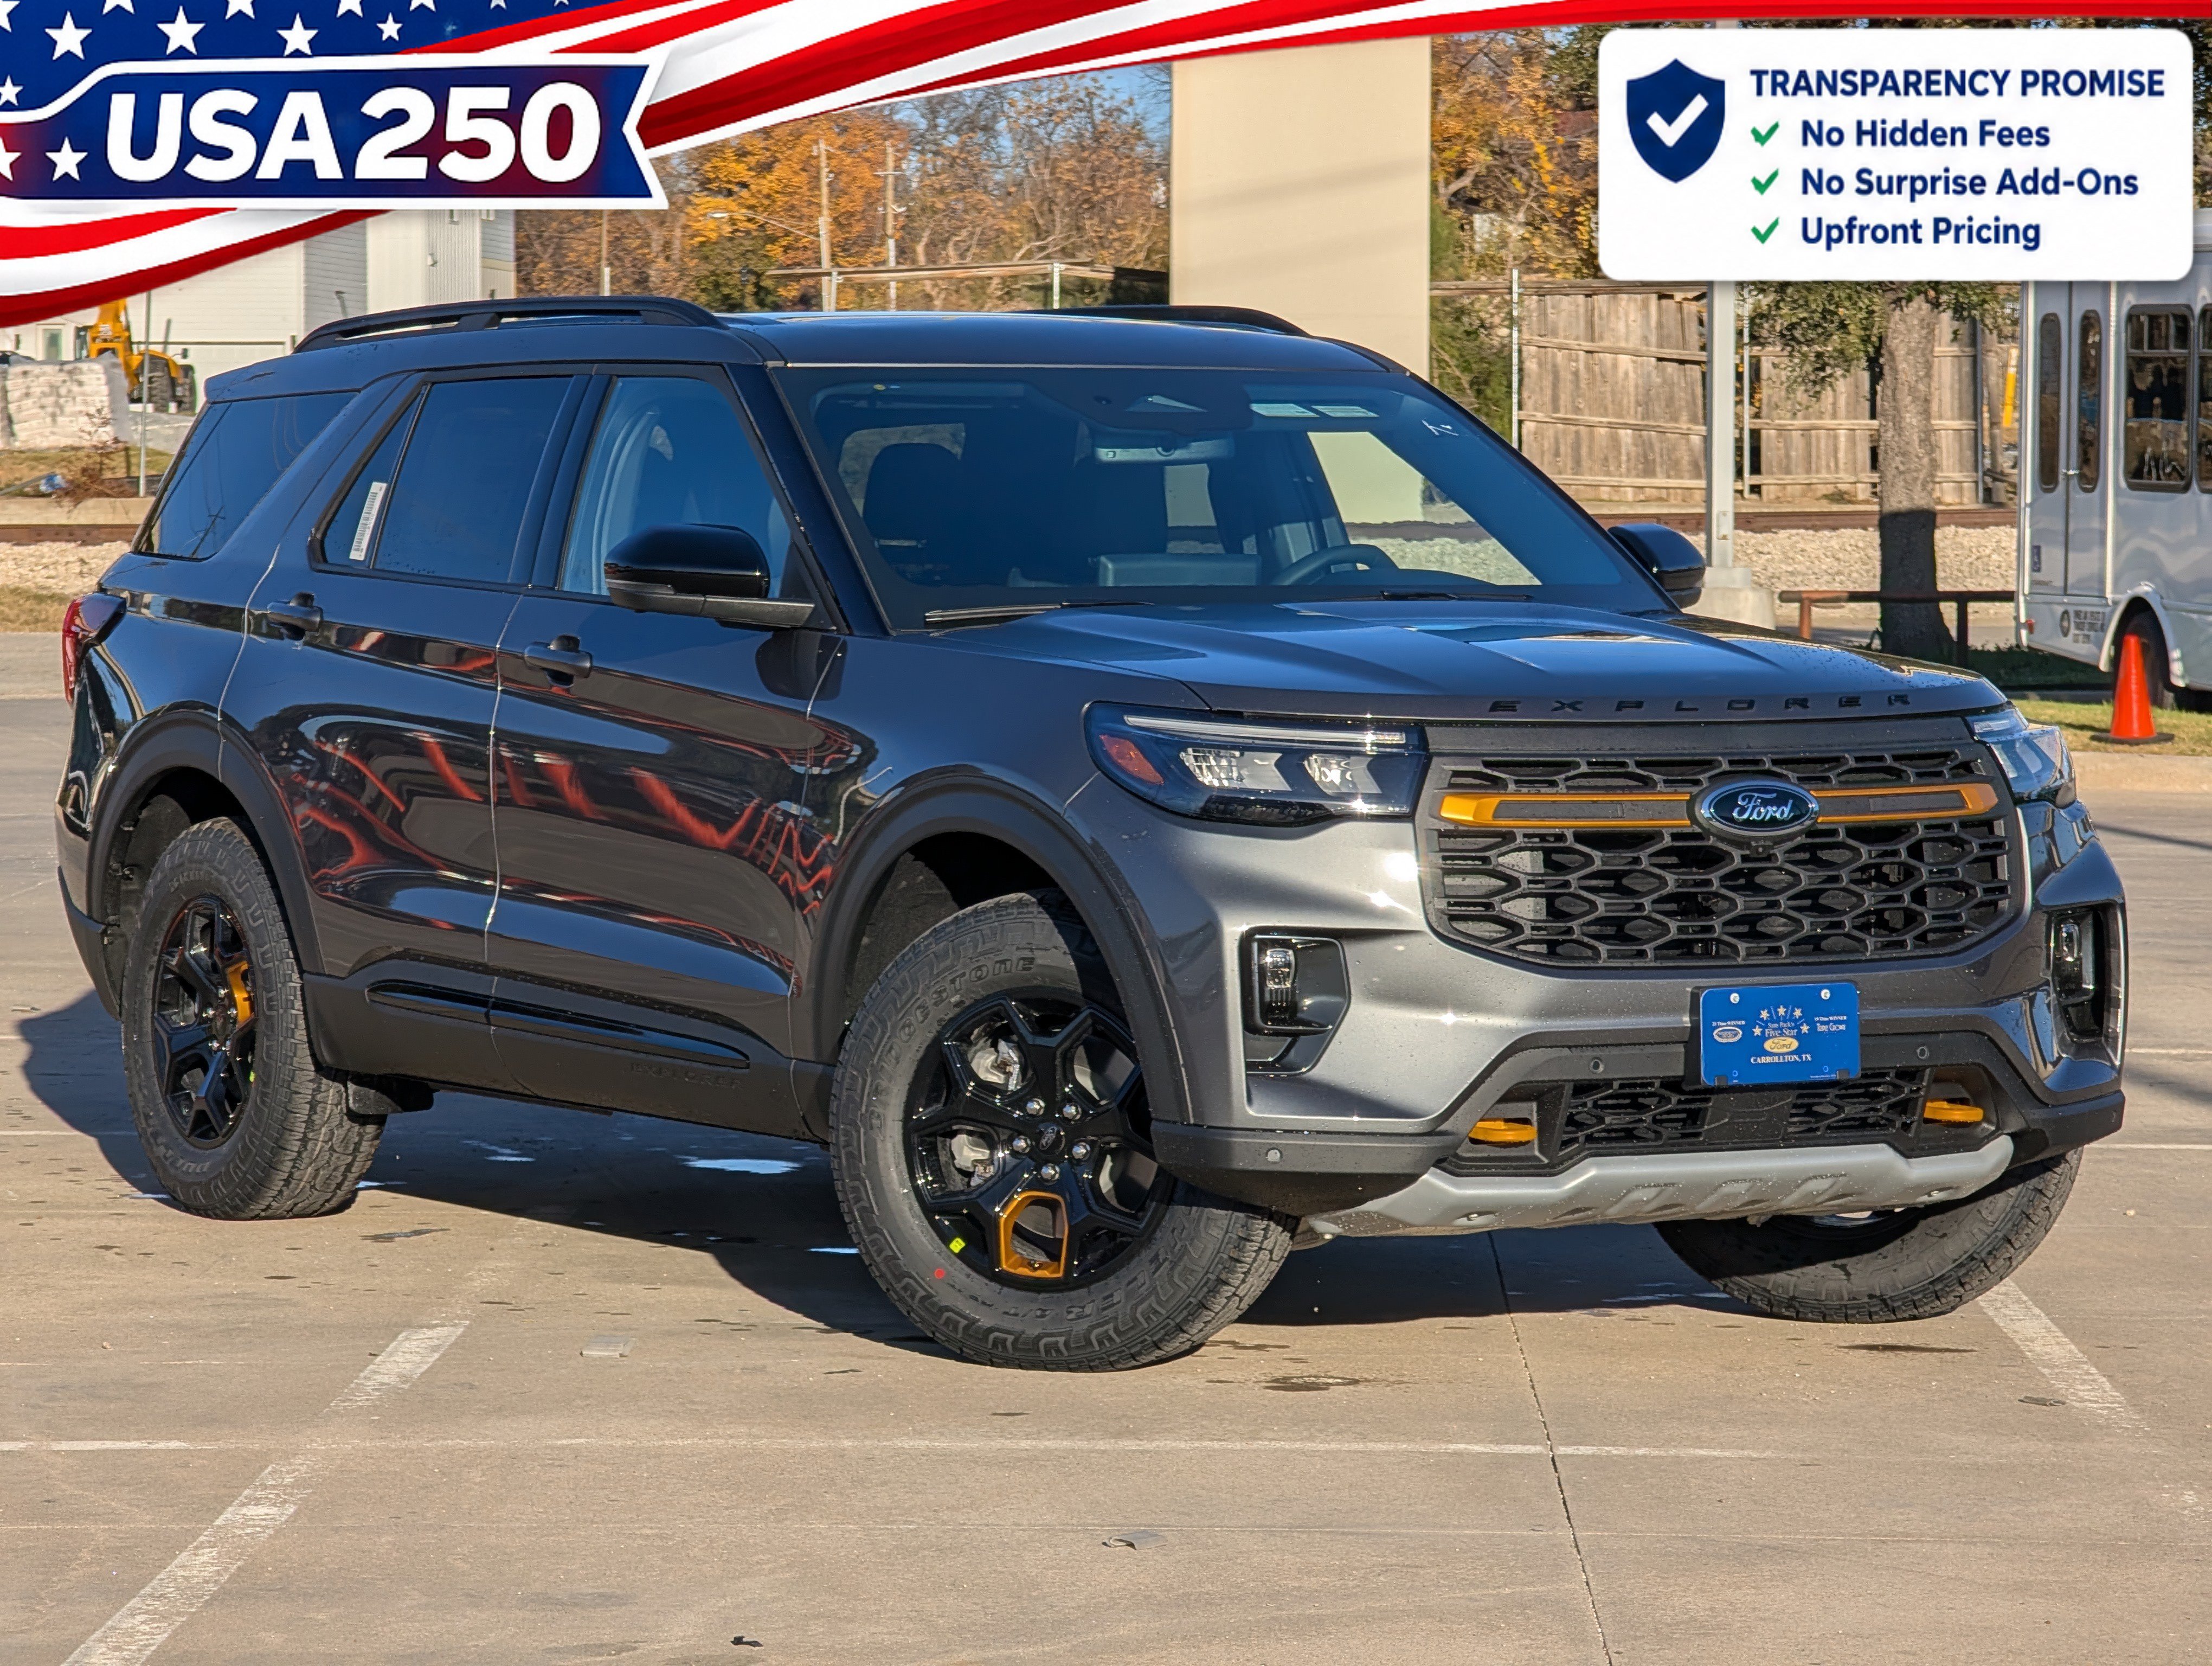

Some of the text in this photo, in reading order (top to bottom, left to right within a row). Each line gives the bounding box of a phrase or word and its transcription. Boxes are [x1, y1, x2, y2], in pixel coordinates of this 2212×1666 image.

[1488, 694, 1911, 713] EXPLORER
[1732, 792, 1794, 822] Ford
[1765, 1028, 1798, 1037] Five Star
[1770, 1038, 1792, 1050] Ford
[1751, 1054, 1801, 1064] CARROLLTON,
